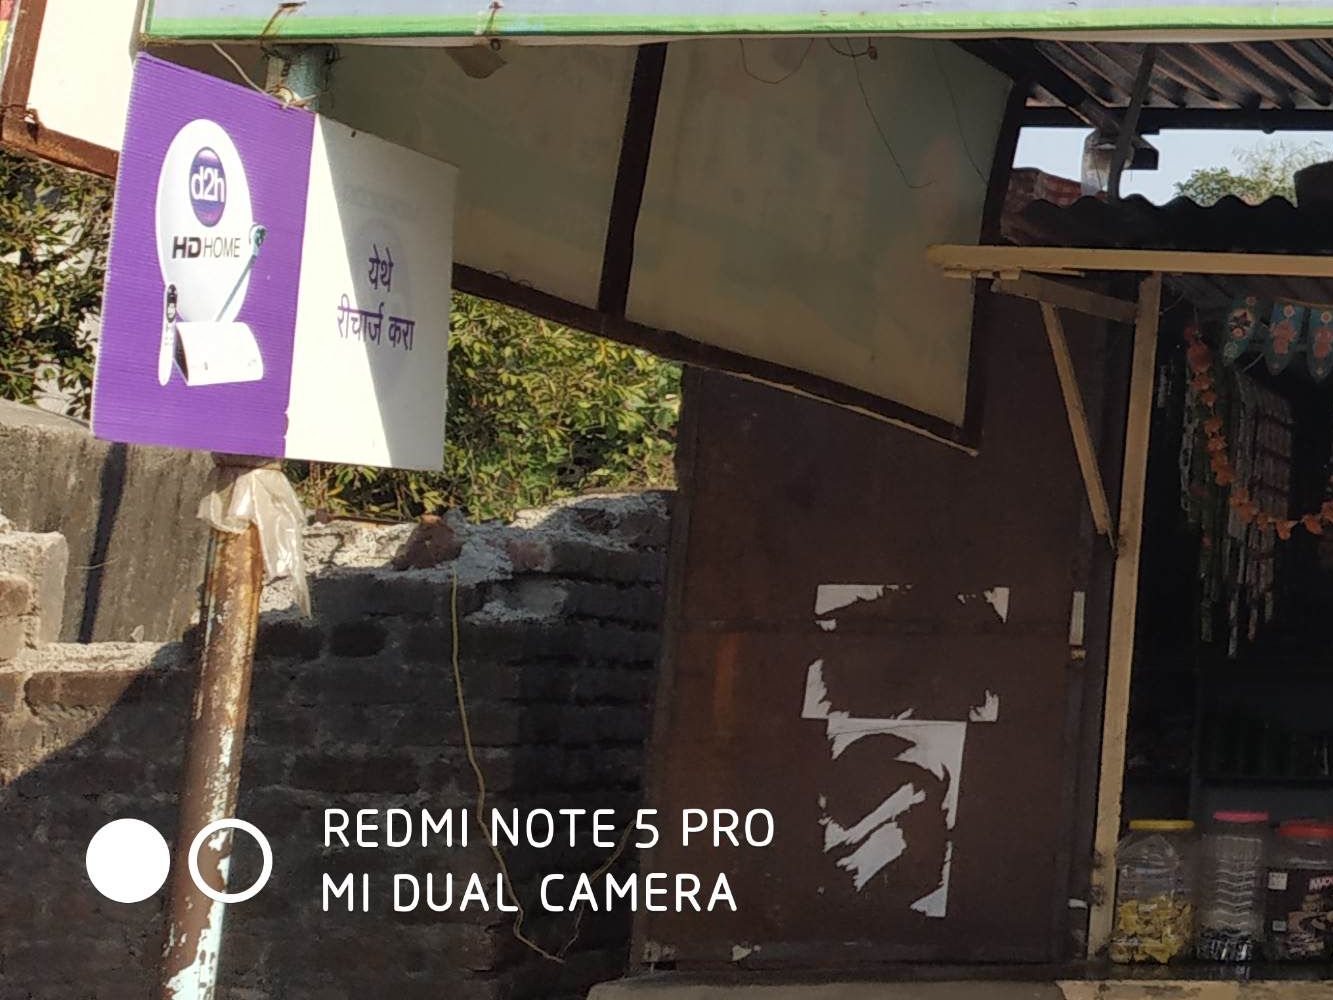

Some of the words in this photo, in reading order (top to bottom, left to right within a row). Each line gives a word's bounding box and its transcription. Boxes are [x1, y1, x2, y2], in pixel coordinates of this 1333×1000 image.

[190, 165, 226, 203] d2h
[367, 243, 394, 293] येथे
[336, 293, 385, 346] रीचार्ज
[388, 315, 416, 351] करा
